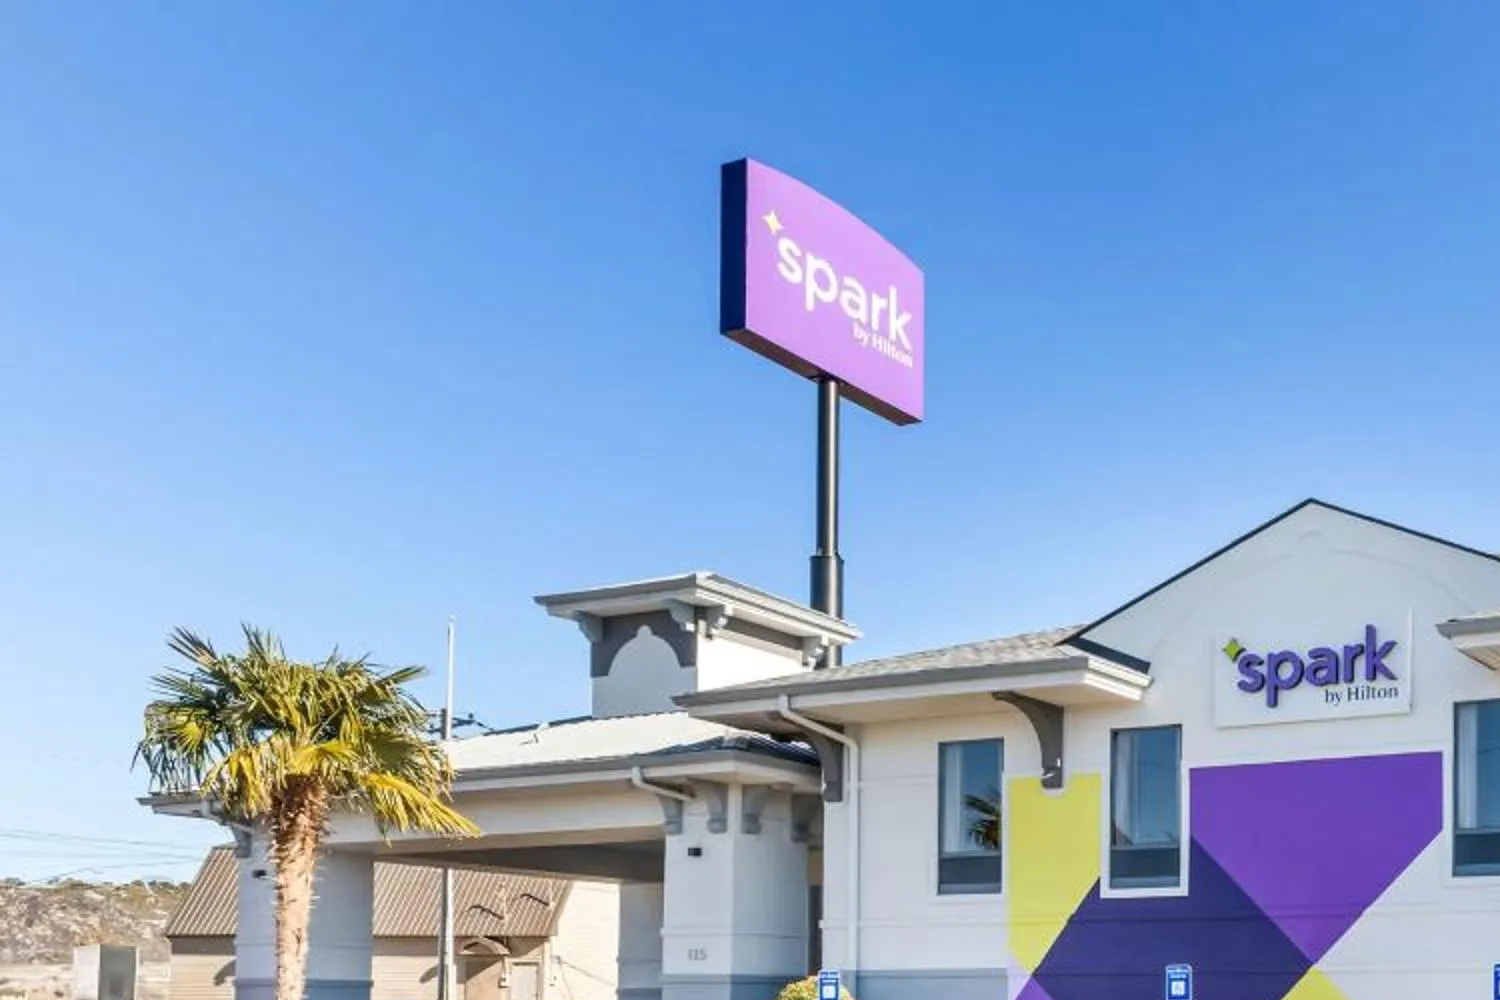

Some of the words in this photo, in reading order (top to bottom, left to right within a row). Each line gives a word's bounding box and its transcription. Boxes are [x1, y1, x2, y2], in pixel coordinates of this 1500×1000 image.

[777, 237, 912, 351] spark
[853, 320, 869, 347] by
[871, 333, 913, 367] Hilton
[1237, 624, 1398, 708] spark
[1324, 688, 1342, 707] by
[1347, 685, 1399, 702] Hilton
